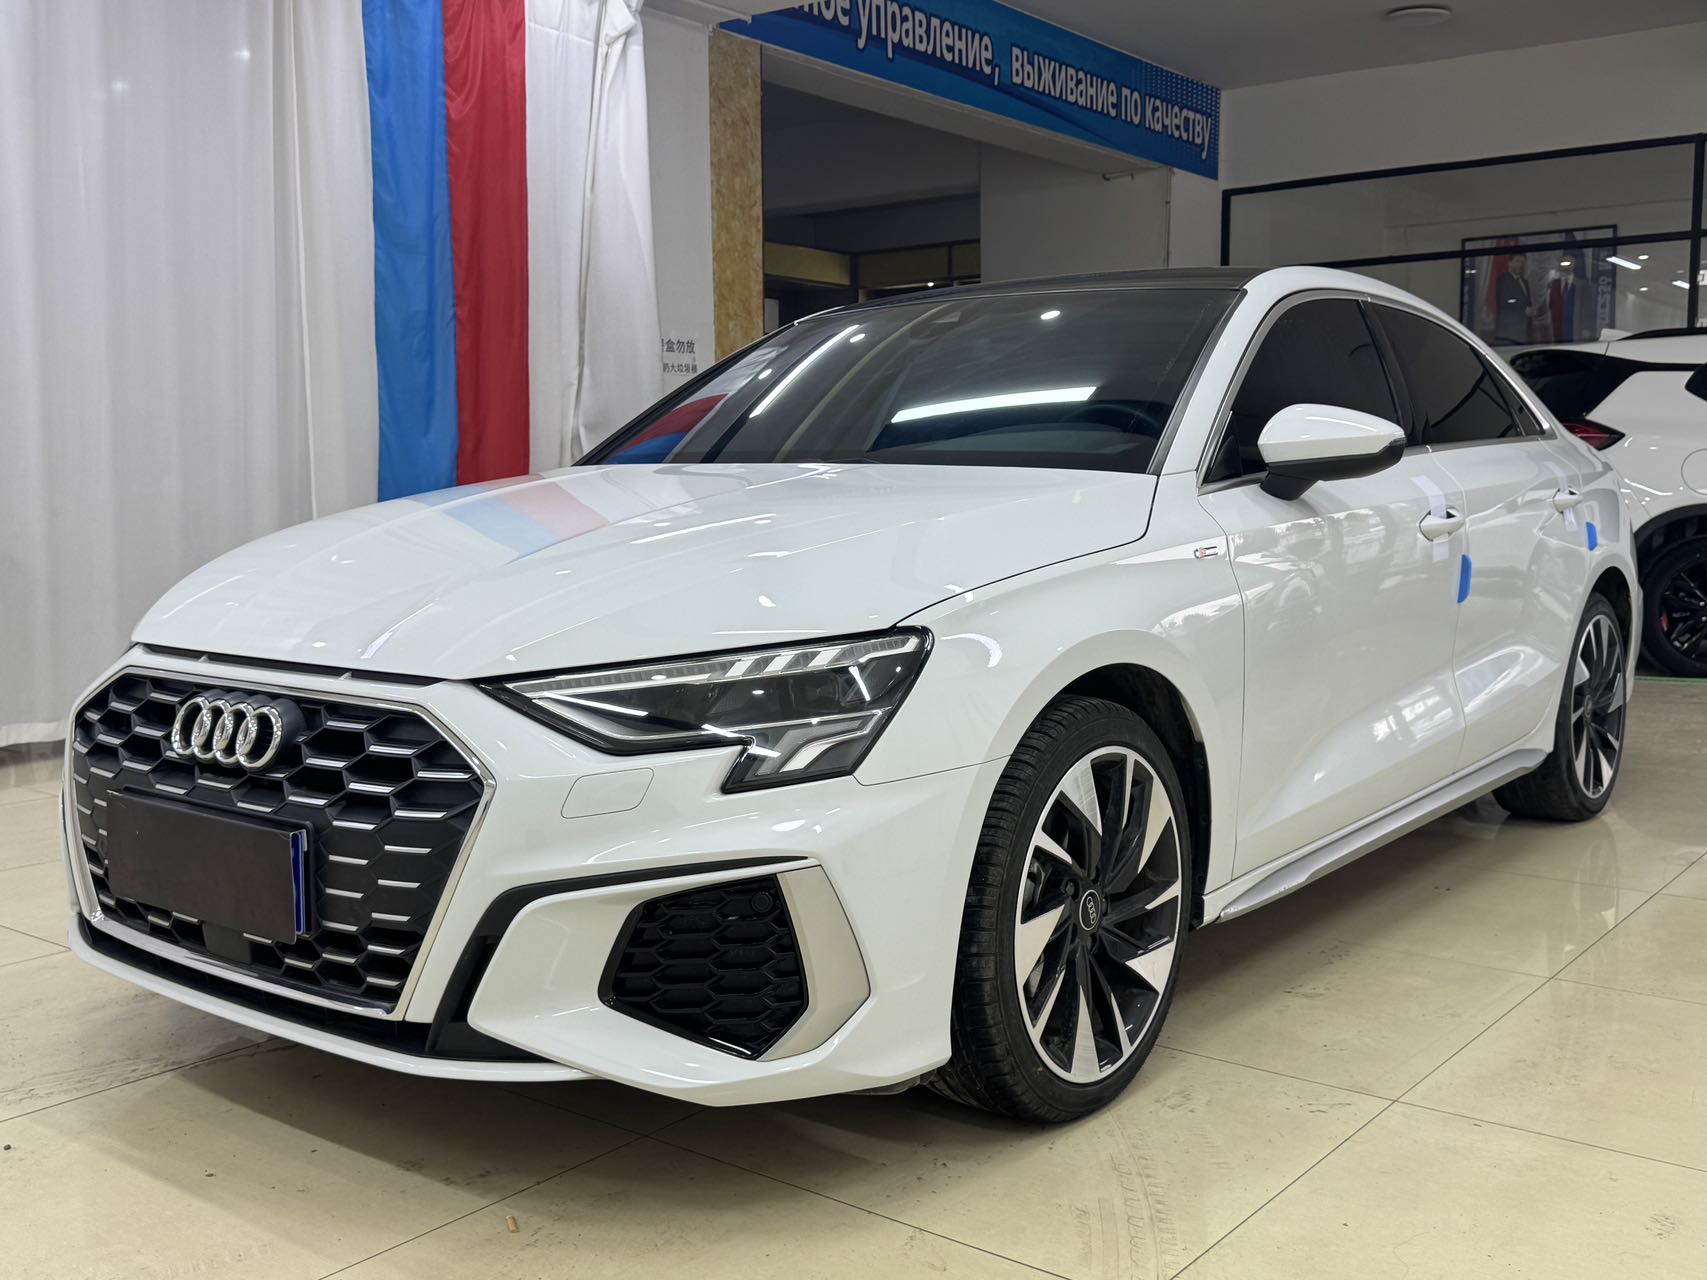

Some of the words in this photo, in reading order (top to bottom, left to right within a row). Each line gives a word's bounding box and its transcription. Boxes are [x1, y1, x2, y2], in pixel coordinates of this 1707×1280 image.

[857, 0, 1000, 86] управление,
[1011, 46, 1117, 118] выживание
[1121, 86, 1142, 125] по
[1146, 95, 1211, 160] качеству
